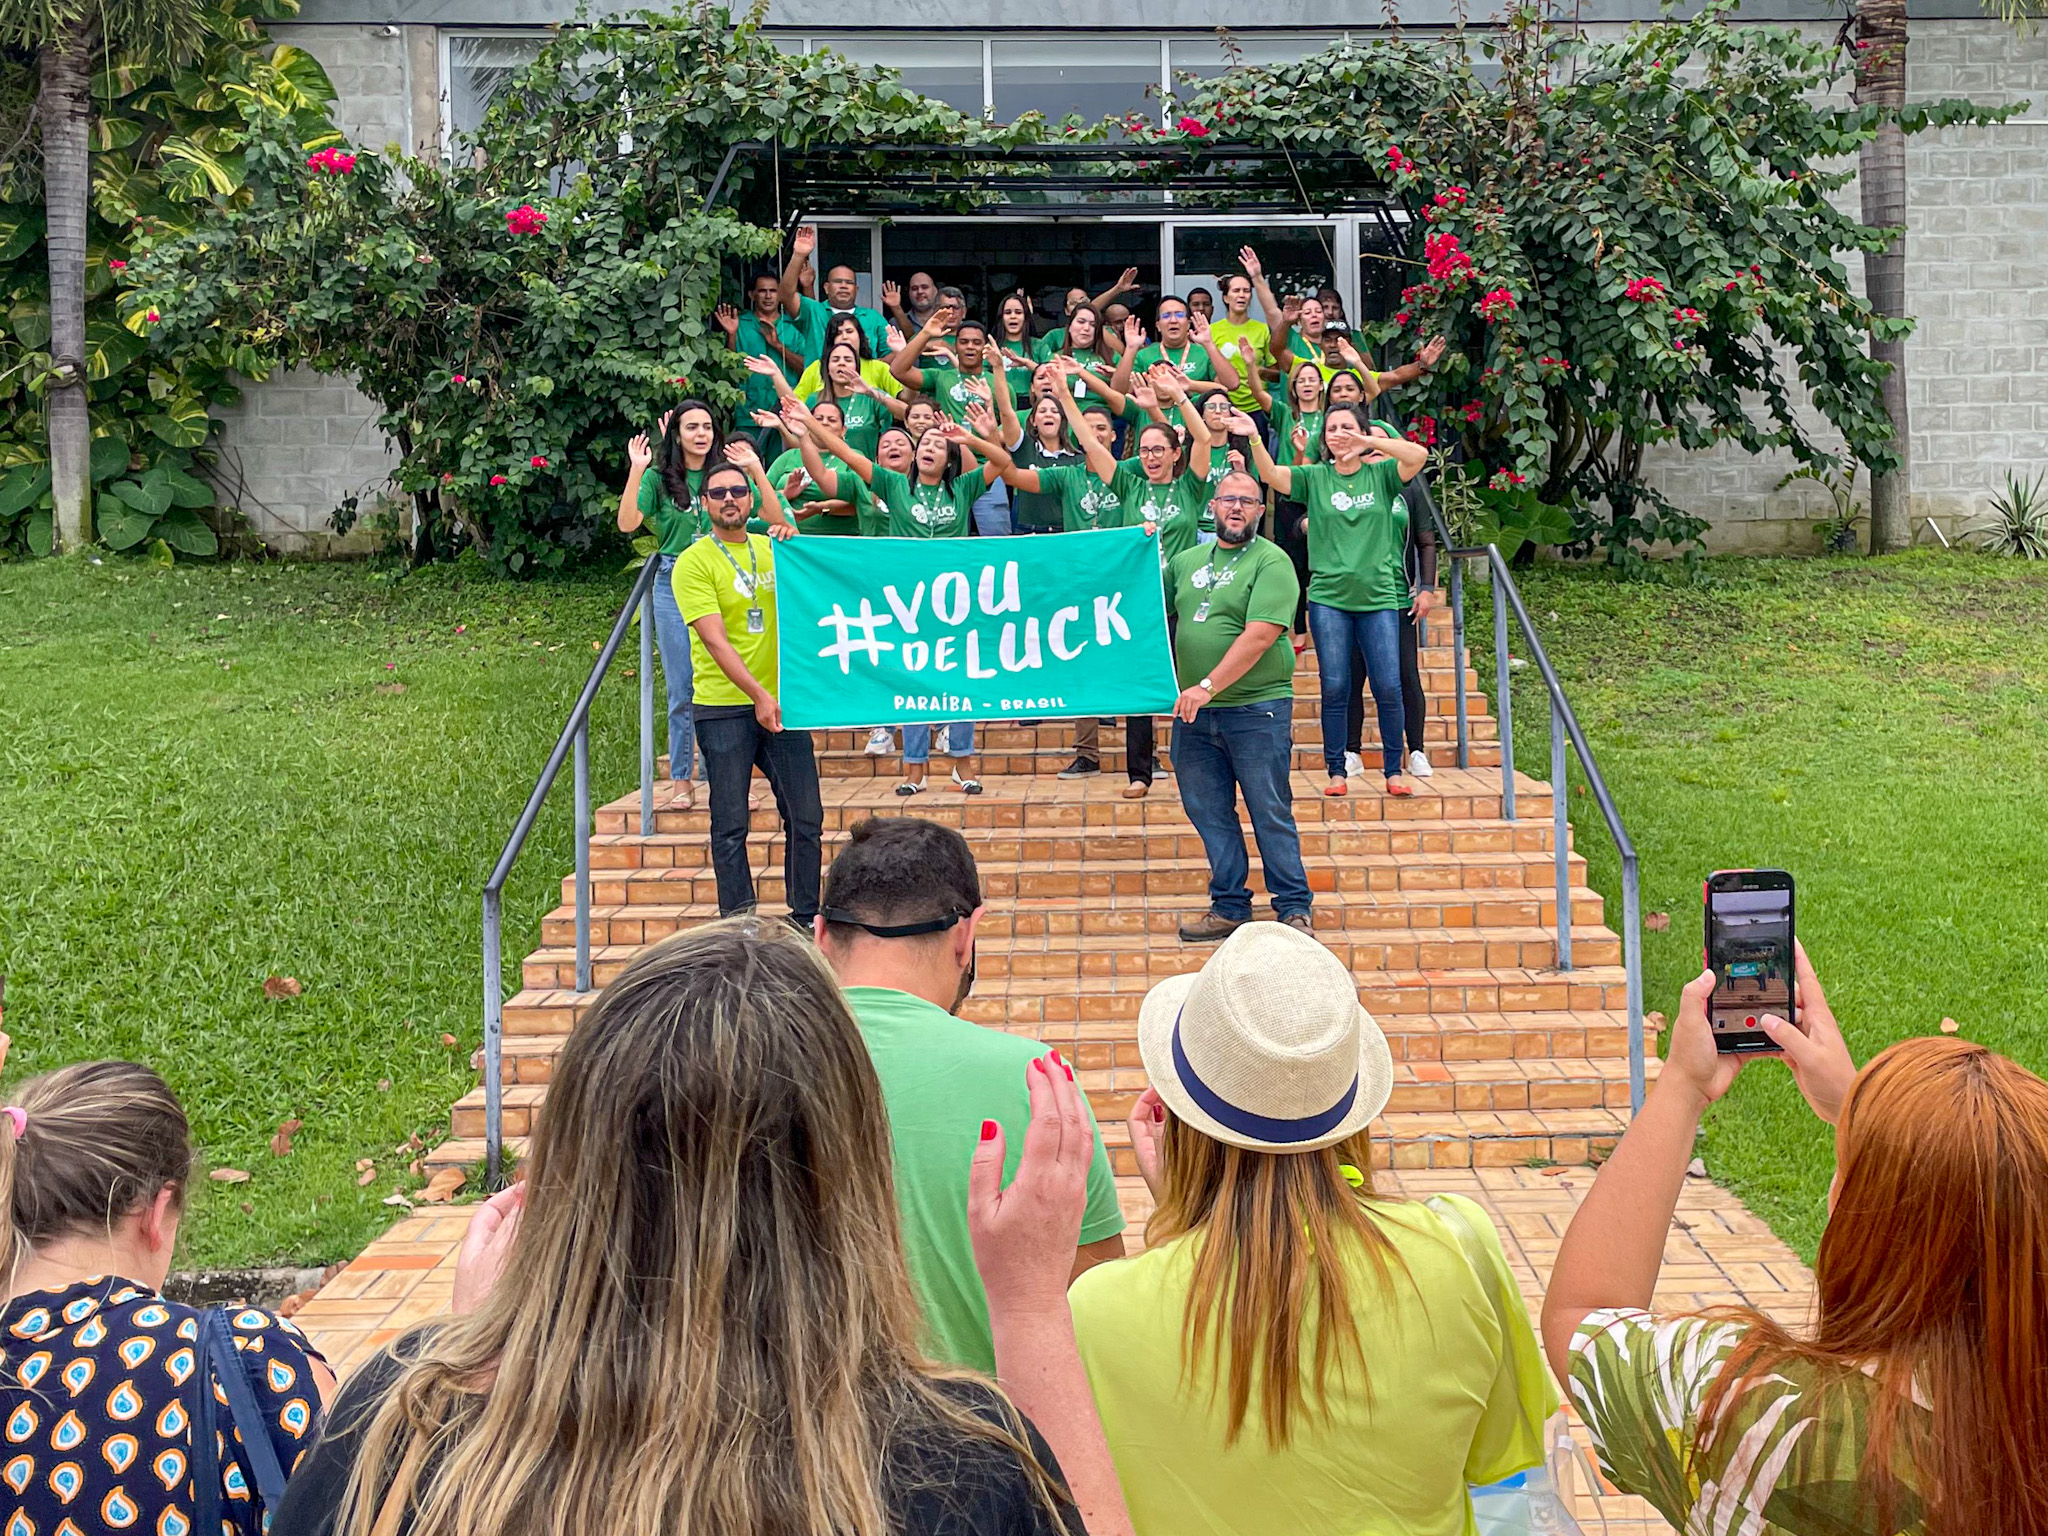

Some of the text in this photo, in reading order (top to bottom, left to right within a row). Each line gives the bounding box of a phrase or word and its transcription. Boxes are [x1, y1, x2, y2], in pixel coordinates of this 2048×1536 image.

[1353, 492, 1375, 504] LUCK
[938, 506, 957, 517] UCK
[893, 693, 973, 712] PARAÍBA
[1001, 697, 1067, 711] BRASIL
